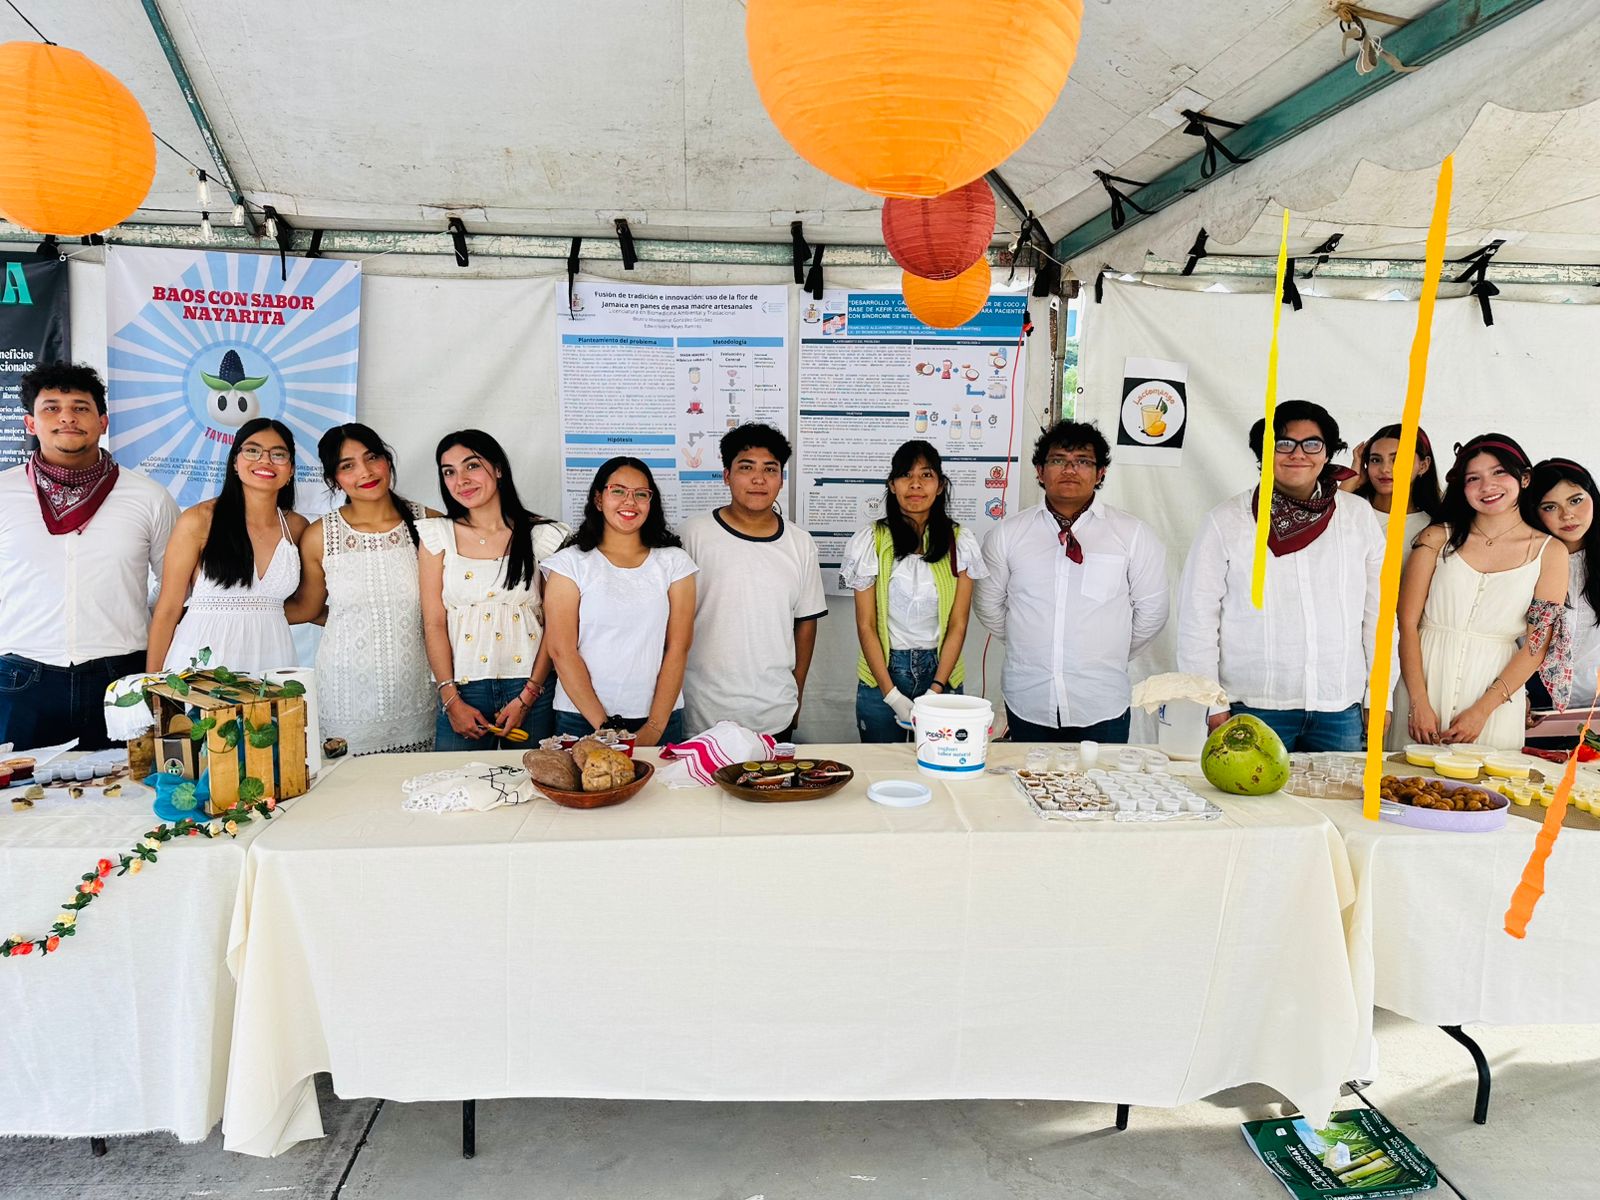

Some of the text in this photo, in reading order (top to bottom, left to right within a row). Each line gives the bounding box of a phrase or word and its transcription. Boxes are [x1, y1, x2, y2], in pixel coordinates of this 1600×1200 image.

[152, 286, 314, 310] BAOS CON SABOR
[594, 290, 617, 298] Fusión
[618, 291, 626, 299] de
[628, 292, 658, 300] tradición
[665, 293, 704, 301] innovación:
[601, 301, 629, 309] Jamaica
[640, 303, 660, 311] panes
[183, 305, 285, 325] NAYARITA
[607, 436, 633, 444] Hipótesis
[1387, 1150, 1401, 1162] 500
[1399, 1149, 1427, 1177] FABRICADOS
